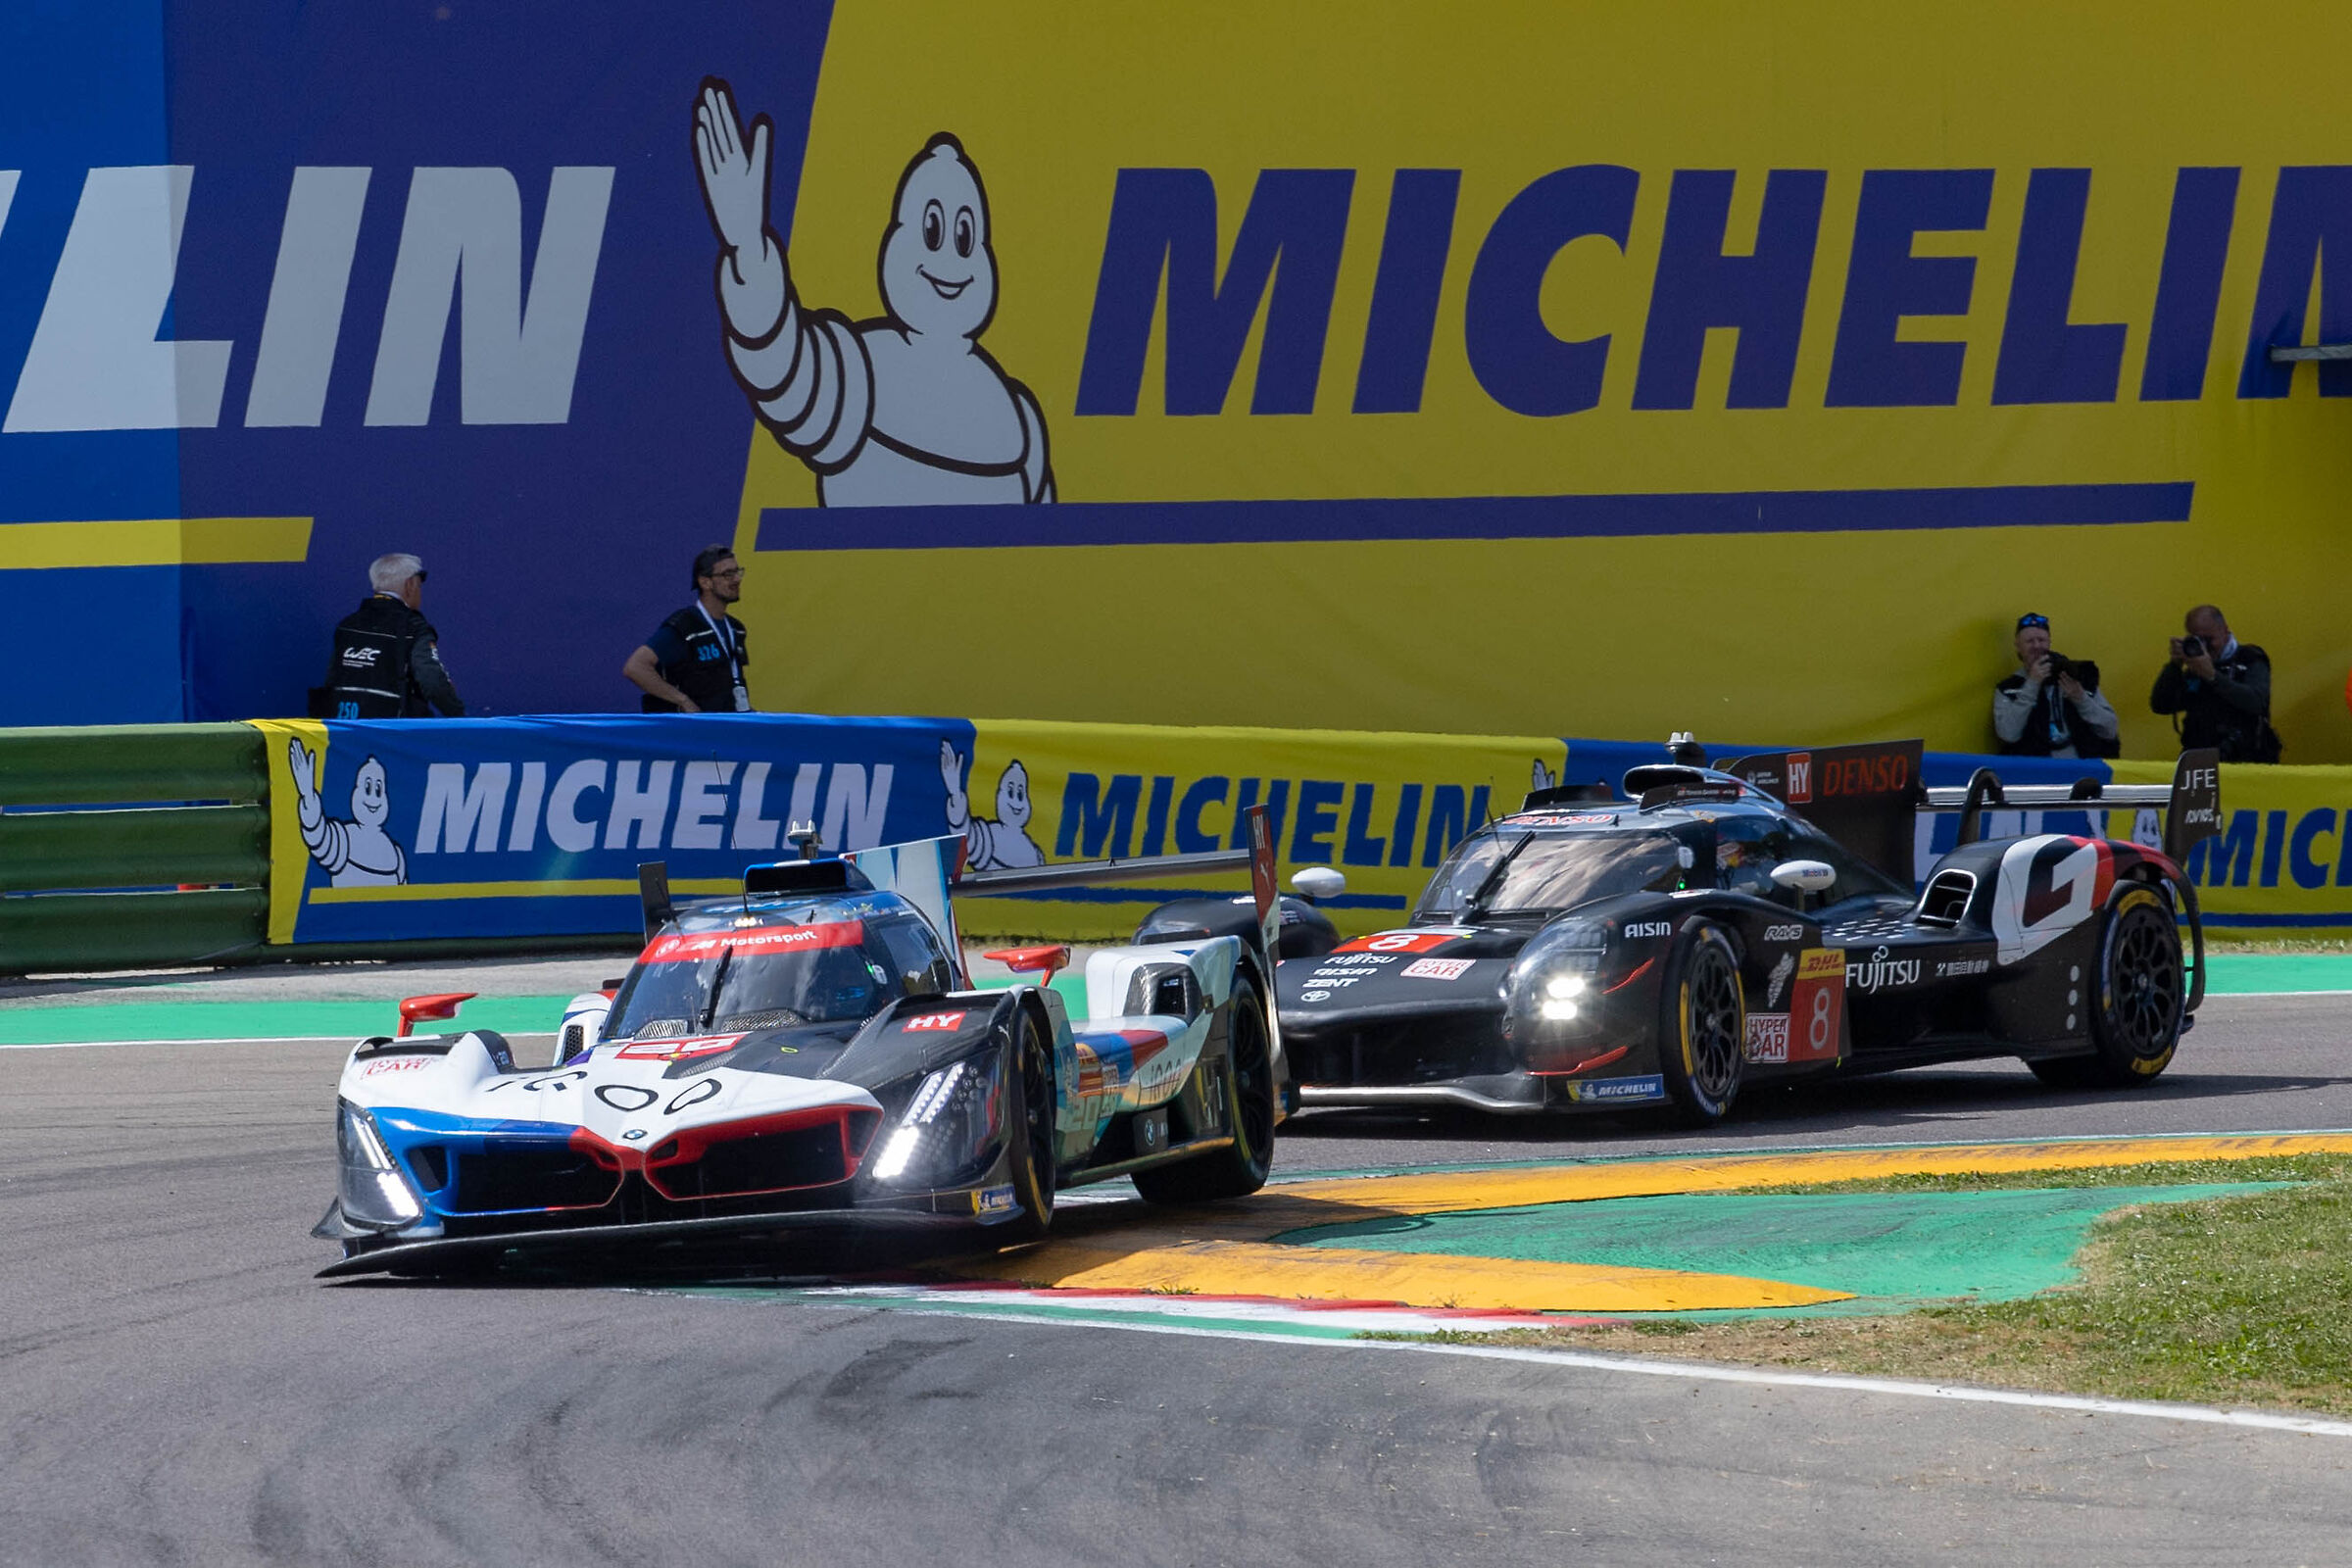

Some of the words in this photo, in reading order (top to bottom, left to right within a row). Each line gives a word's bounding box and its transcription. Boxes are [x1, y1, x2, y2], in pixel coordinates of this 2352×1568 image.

[0, 165, 615, 433] LIN
[1788, 762, 1809, 794] HY
[1823, 755, 1908, 797] DENSO
[2180, 768, 2216, 790] JFE
[415, 760, 894, 853] MICHELIN
[1054, 772, 1491, 868] MICHELIN
[2188, 808, 2352, 886] MIC
[720, 930, 817, 948] Motorsport
[1625, 922, 1672, 938] AISIN
[1764, 924, 1803, 941] RAYS
[1368, 934, 1419, 951] 8
[1324, 955, 1398, 965] FUJITSU
[1411, 966, 1459, 977] CAR
[1844, 958, 1921, 995] FUJITSU
[1302, 978, 1359, 988] ZENT
[907, 1013, 961, 1029] HY
[1749, 1019, 1788, 1033] HYPER
[1810, 987, 1830, 1051] 8
[1750, 1034, 1785, 1056] CAR
[1598, 1083, 1657, 1096] MICHELIN
